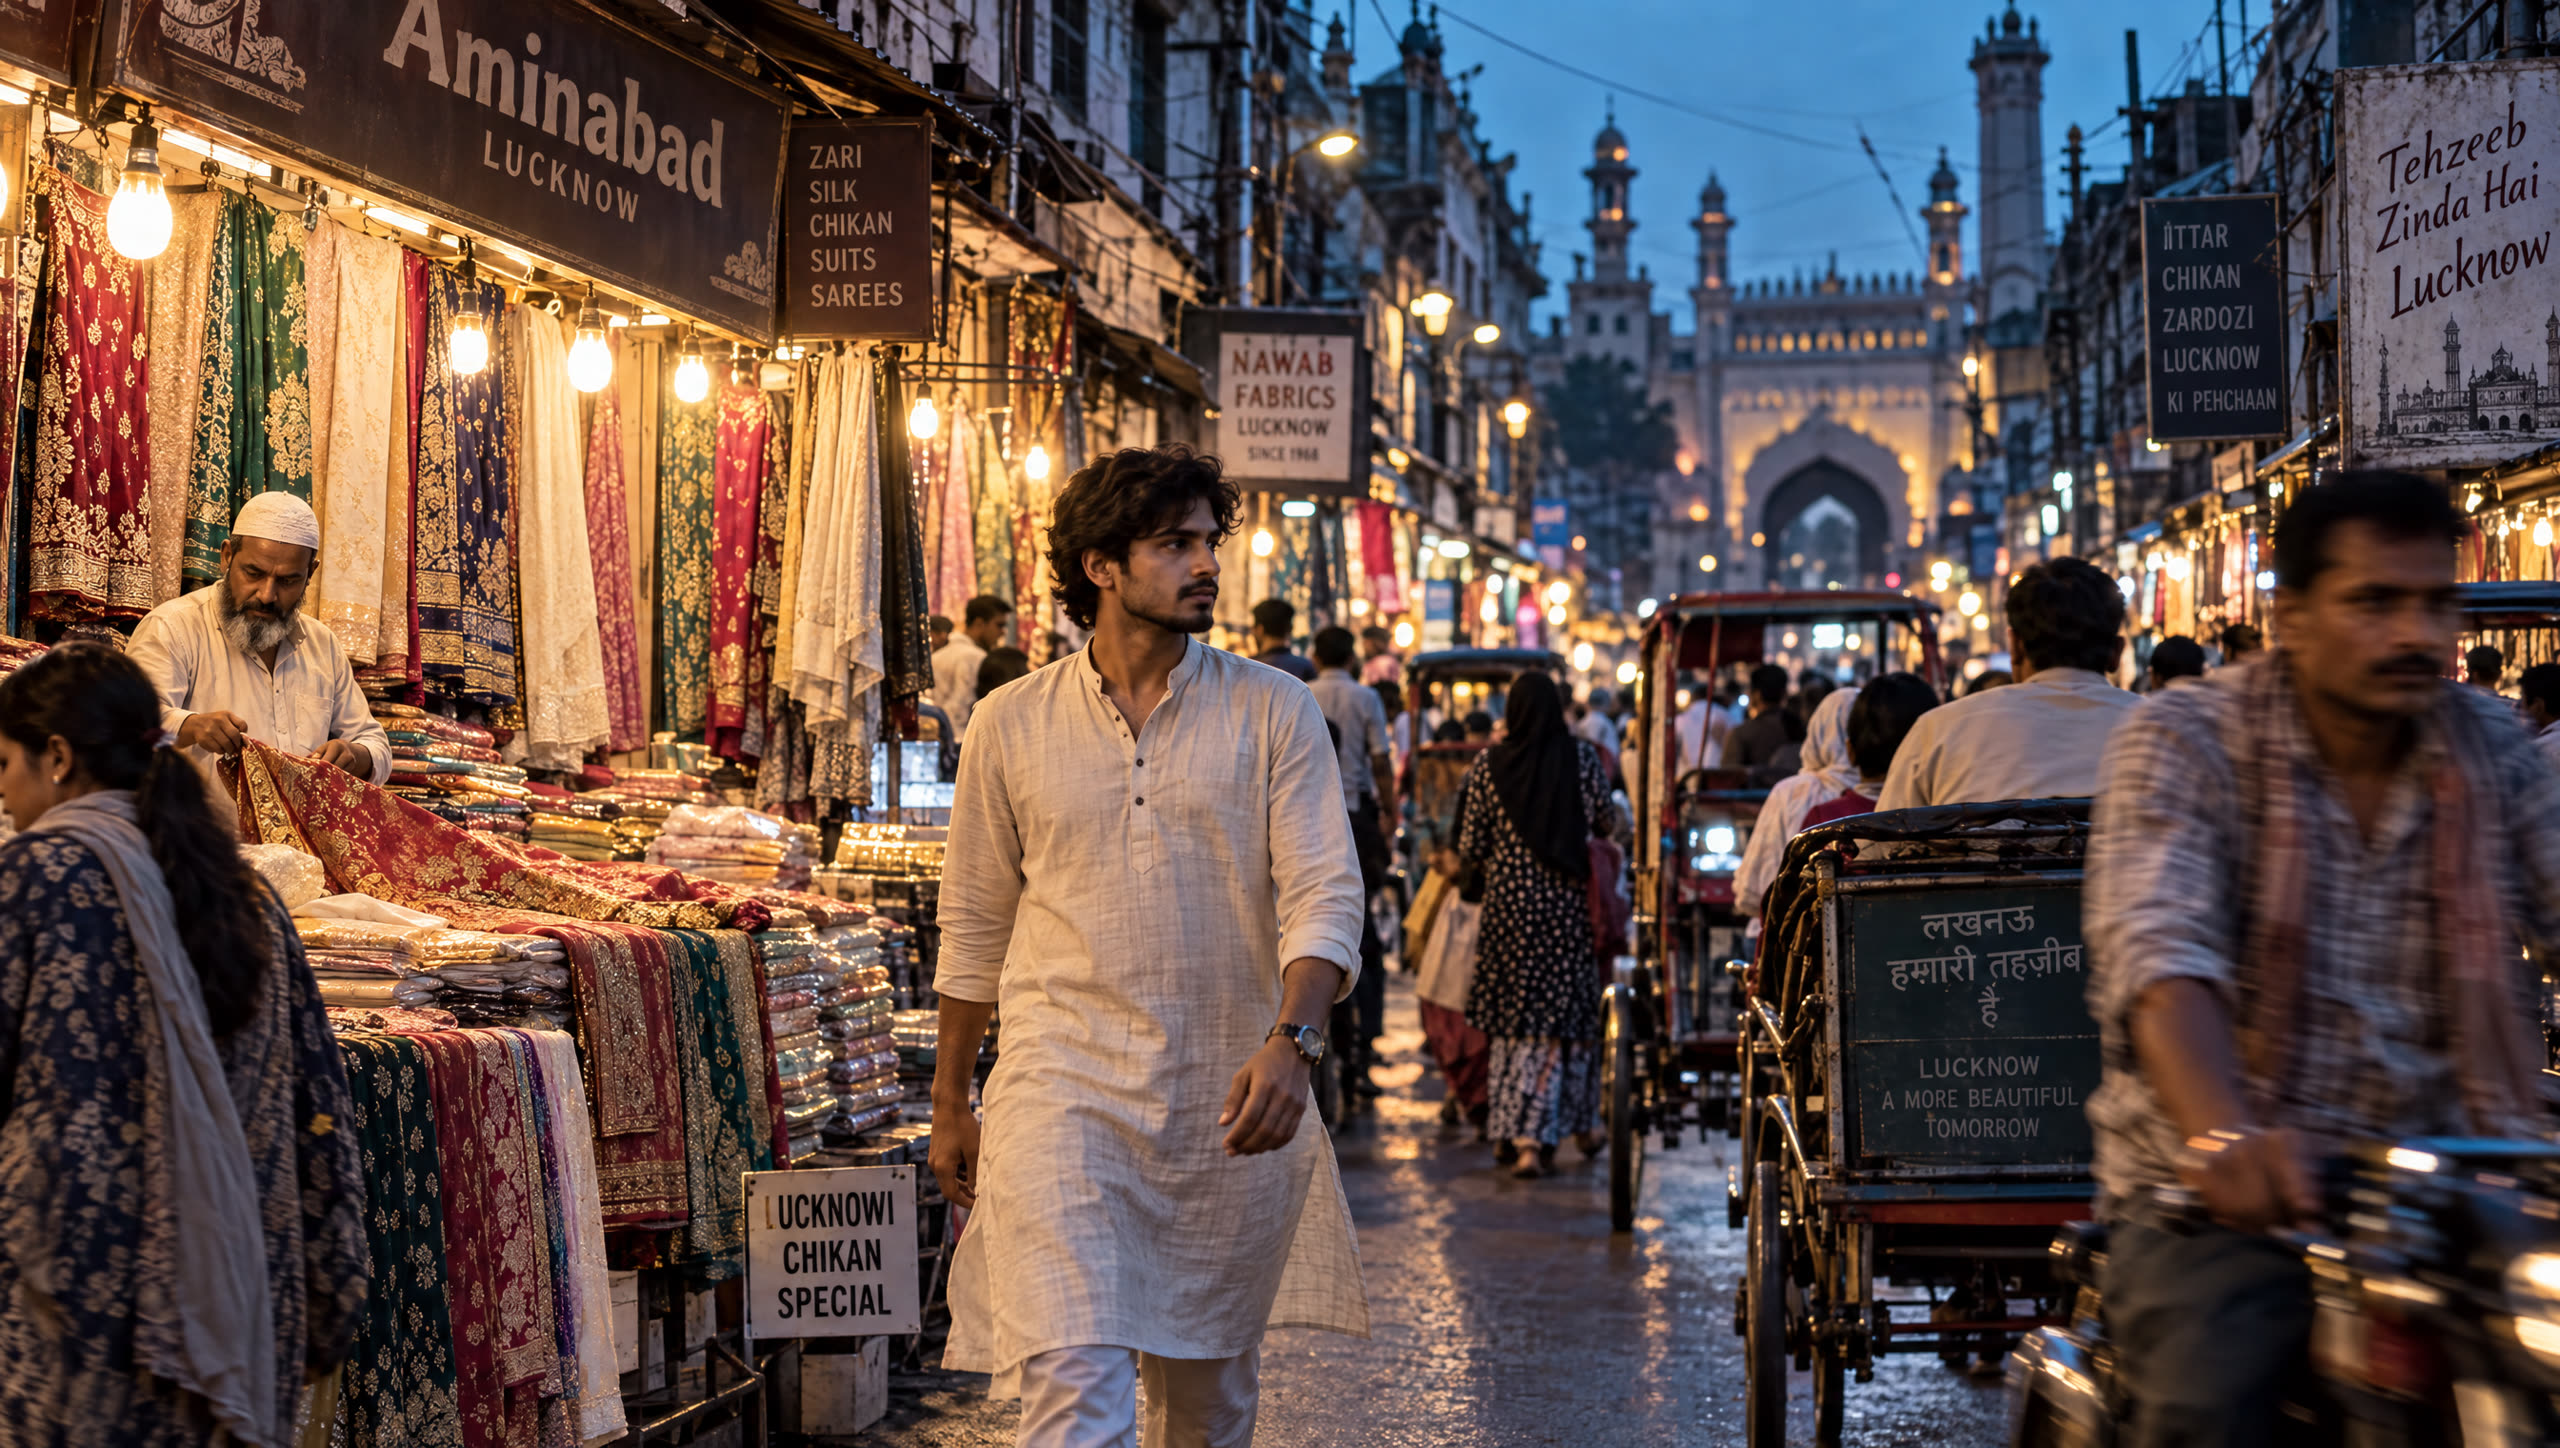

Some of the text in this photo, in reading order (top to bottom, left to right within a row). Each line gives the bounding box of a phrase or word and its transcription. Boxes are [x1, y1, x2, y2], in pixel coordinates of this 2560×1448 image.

[383, 0, 724, 208] Aminabad
[809, 145, 862, 169] ZARI
[2377, 101, 2526, 194] Tehzeeb
[484, 130, 639, 223] LUCKNOW
[809, 179, 858, 204] SILK
[2376, 161, 2539, 254] Zinda Hai
[809, 211, 893, 237] CHIKAN
[810, 247, 877, 272] SUITS
[2162, 264, 2241, 292] CHIKAN
[2390, 231, 2551, 320] Lucknow
[811, 282, 904, 307] SAREES
[2162, 305, 2253, 332] ZARDOZI
[1232, 350, 1334, 376] NAWAB
[2163, 345, 2260, 373] LUCKNOW
[1235, 384, 1336, 410] FABRICS
[2167, 388, 2277, 413] KI PEHCHAAN
[1237, 418, 1331, 437] LUCKNOW
[1248, 446, 1285, 462] SINCE
[1921, 905, 2035, 940] लखनऊ
[1987, 936, 2083, 981] तहज़ीब
[1978, 985, 2001, 1028] है
[1919, 1055, 2040, 1079] LUCKNOW
[1882, 1087, 2079, 1110] A MORE BEAUTIFUL
[1925, 1118, 2040, 1138] TOMORROW
[765, 1191, 894, 1230] LUCKNOWI
[783, 1239, 882, 1274] CHIKAN
[778, 1284, 892, 1319] SPECIAL
